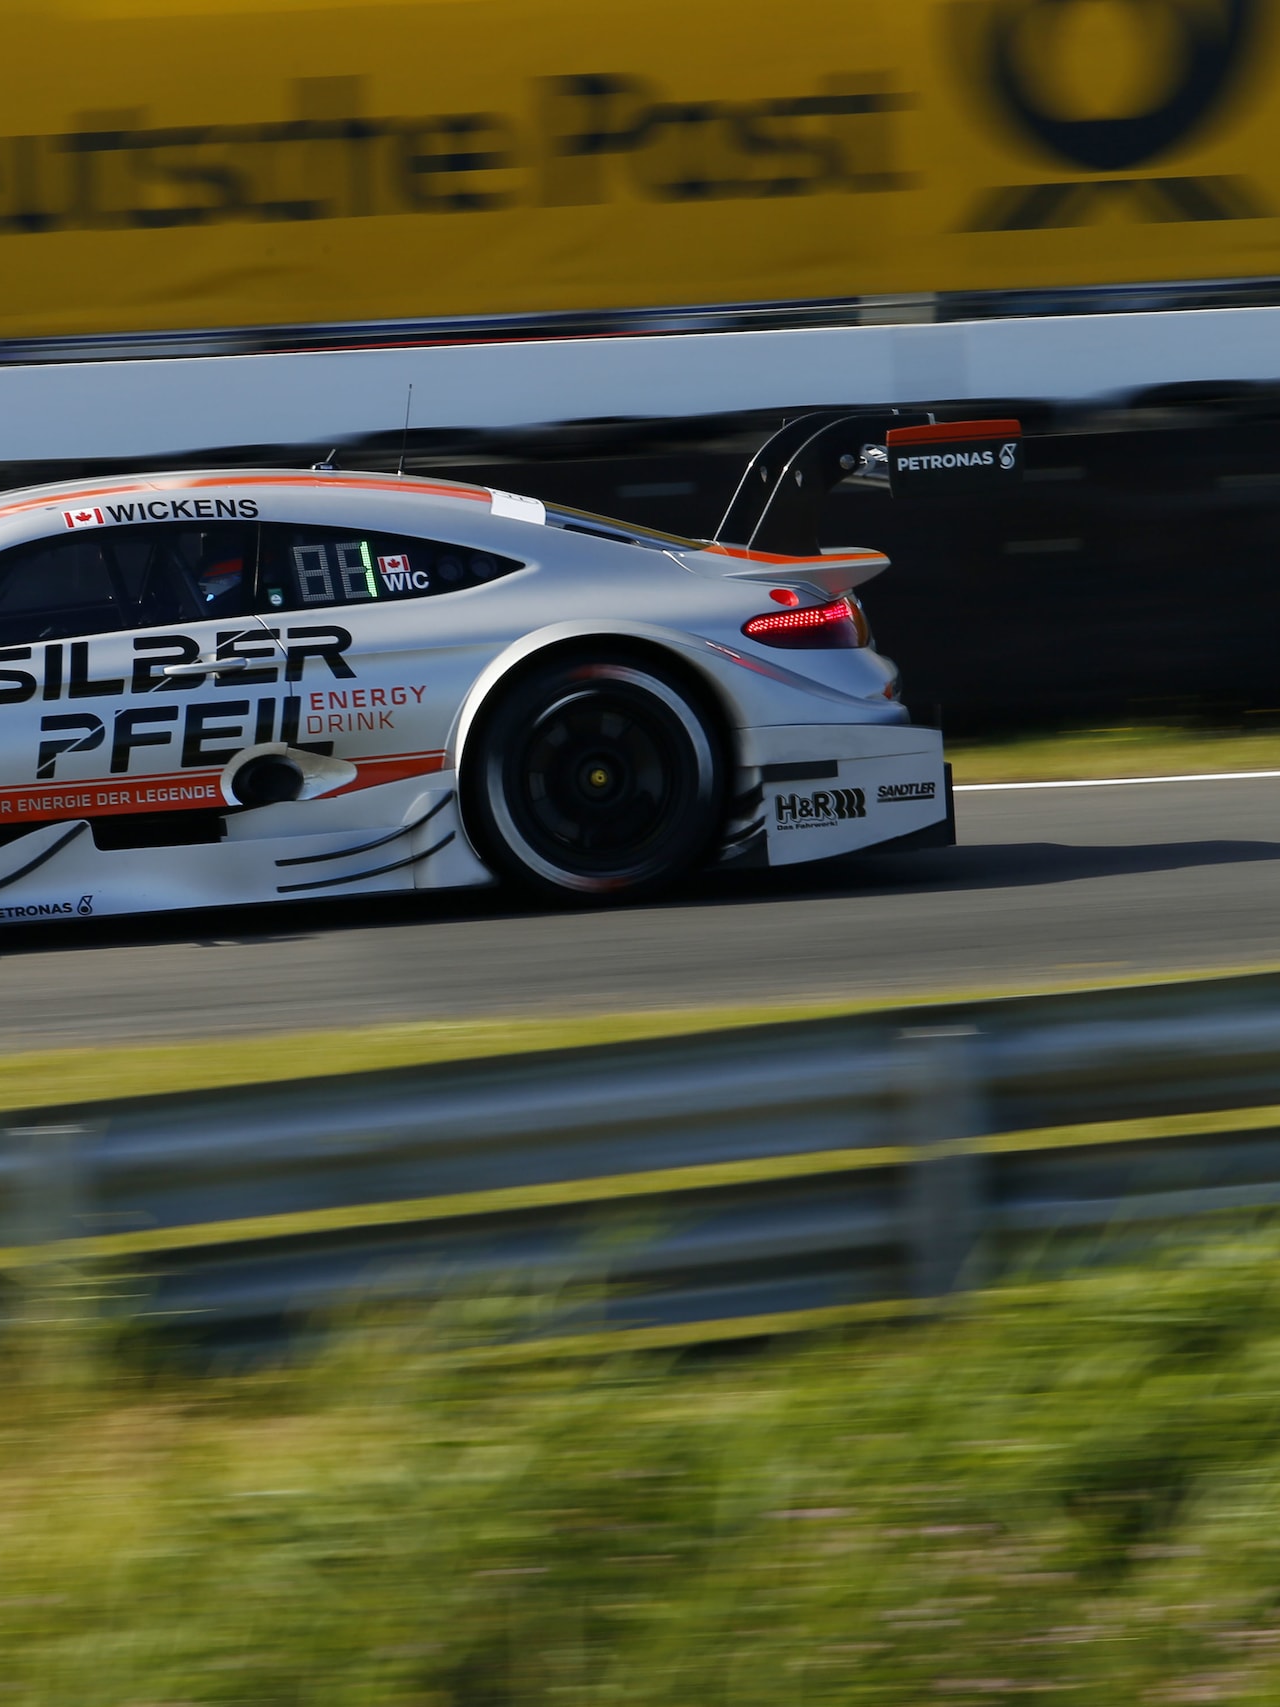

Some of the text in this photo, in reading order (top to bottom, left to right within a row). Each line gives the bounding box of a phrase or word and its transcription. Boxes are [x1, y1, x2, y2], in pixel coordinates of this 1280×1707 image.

[897, 451, 994, 471] PETRONAS
[105, 499, 259, 523] WICKENS
[381, 571, 429, 592] WIC
[310, 685, 427, 711] ENERGY
[307, 710, 396, 735] DRINK
[36, 696, 334, 779] PFEIL
[17, 794, 93, 814] ENERGIE
[96, 790, 132, 806] DER
[136, 785, 216, 804] LEGENDE
[877, 782, 936, 797] SANDTLER
[775, 791, 838, 824] H&R
[777, 823, 793, 831] Das
